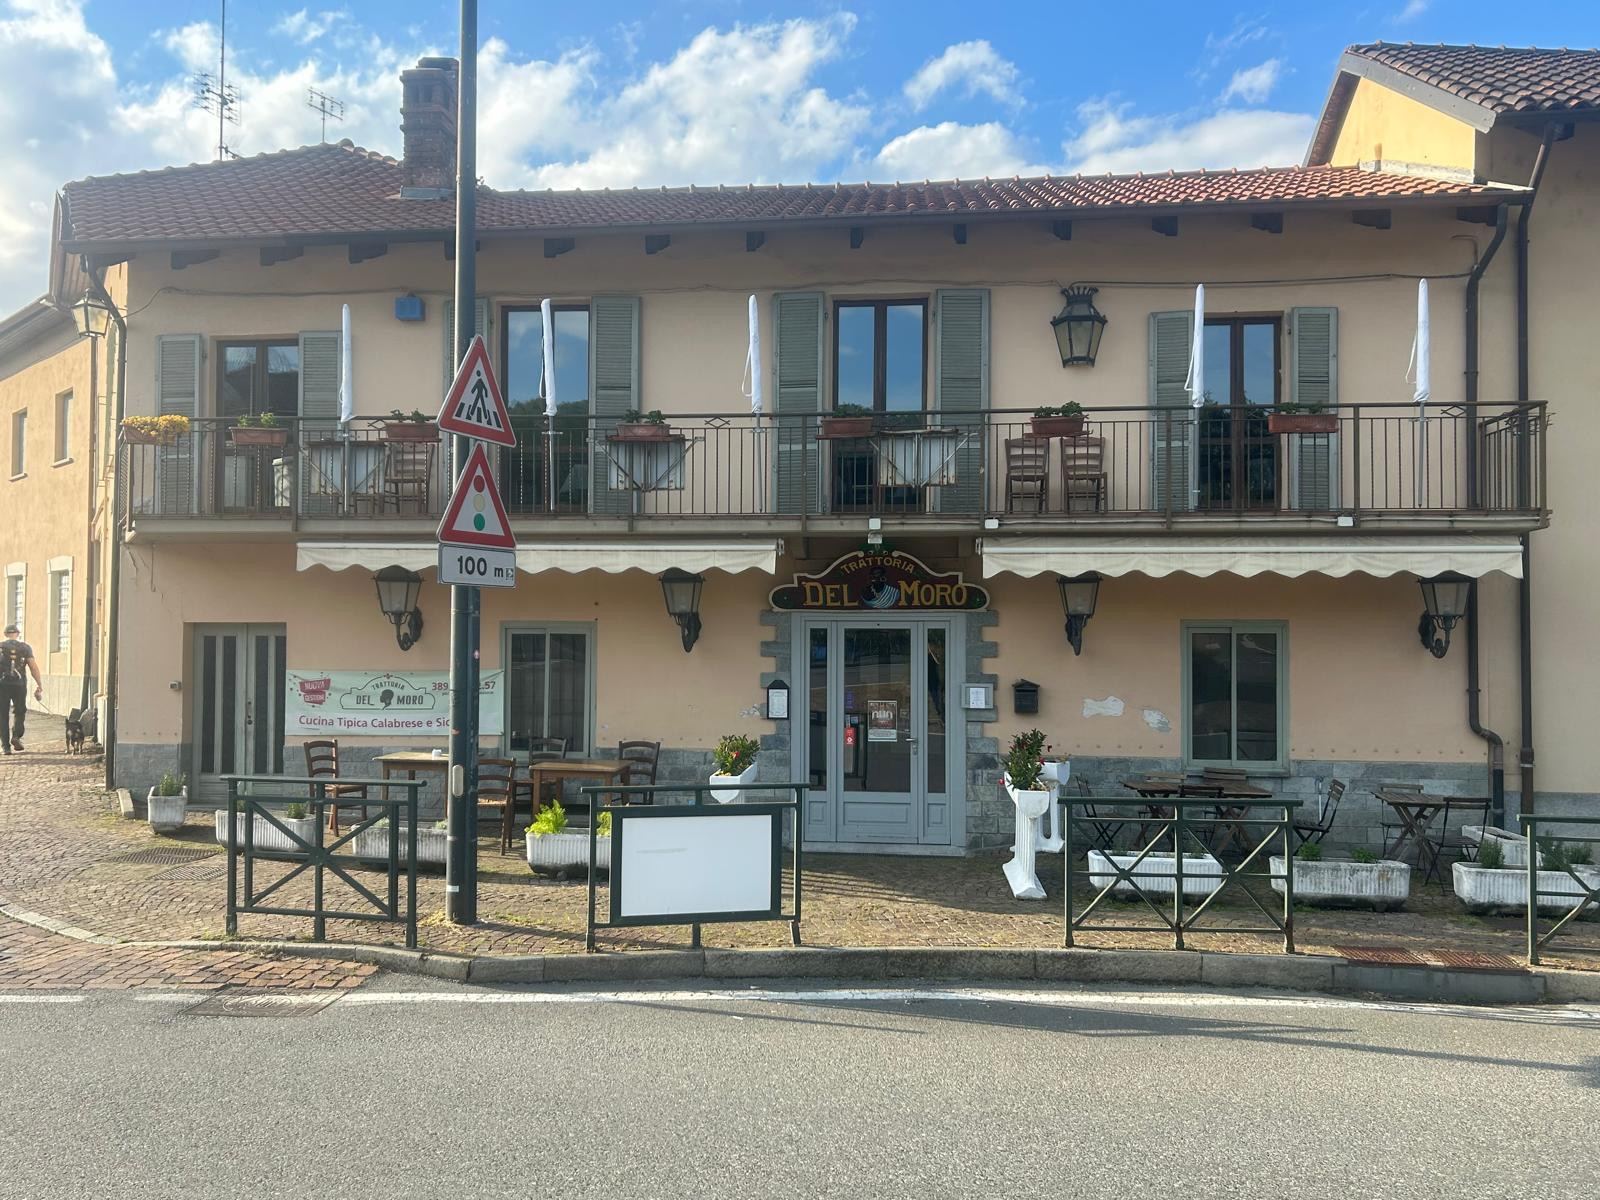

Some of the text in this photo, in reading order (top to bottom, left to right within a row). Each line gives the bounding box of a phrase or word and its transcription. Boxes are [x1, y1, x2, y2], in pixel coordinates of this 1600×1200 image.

[457, 555, 504, 578] 100 m
[840, 556, 915, 574] TRATTORIA
[802, 580, 968, 606] DEL MORO
[371, 681, 405, 690] TRATTORIA
[356, 695, 424, 706] DEL MORO
[299, 715, 334, 726] Cucina
[337, 717, 368, 729] Tipica
[371, 717, 423, 728] Calabrese
